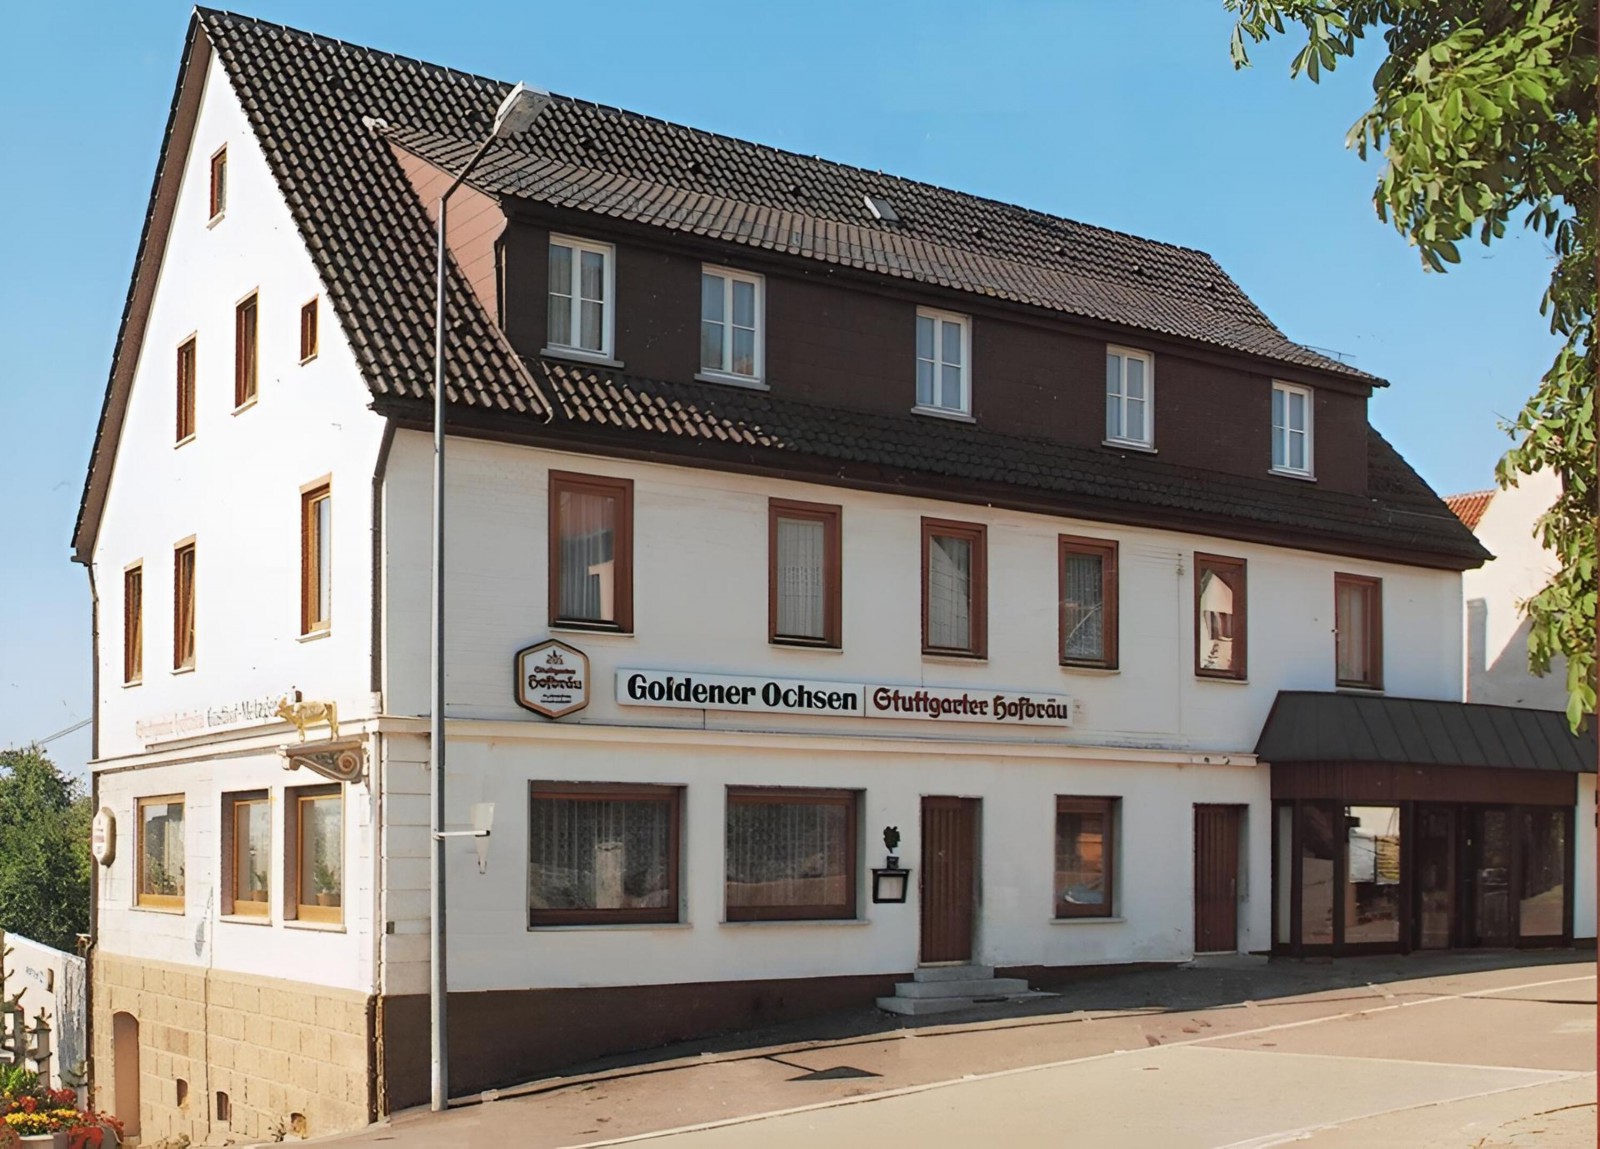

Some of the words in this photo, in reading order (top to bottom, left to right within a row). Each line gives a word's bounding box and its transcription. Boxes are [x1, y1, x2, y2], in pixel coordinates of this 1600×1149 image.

[627, 674, 756, 705] Goldener
[762, 682, 857, 710] Ochsen
[873, 687, 988, 718] Stuttgarter
[993, 694, 1068, 720] Hofbräu
